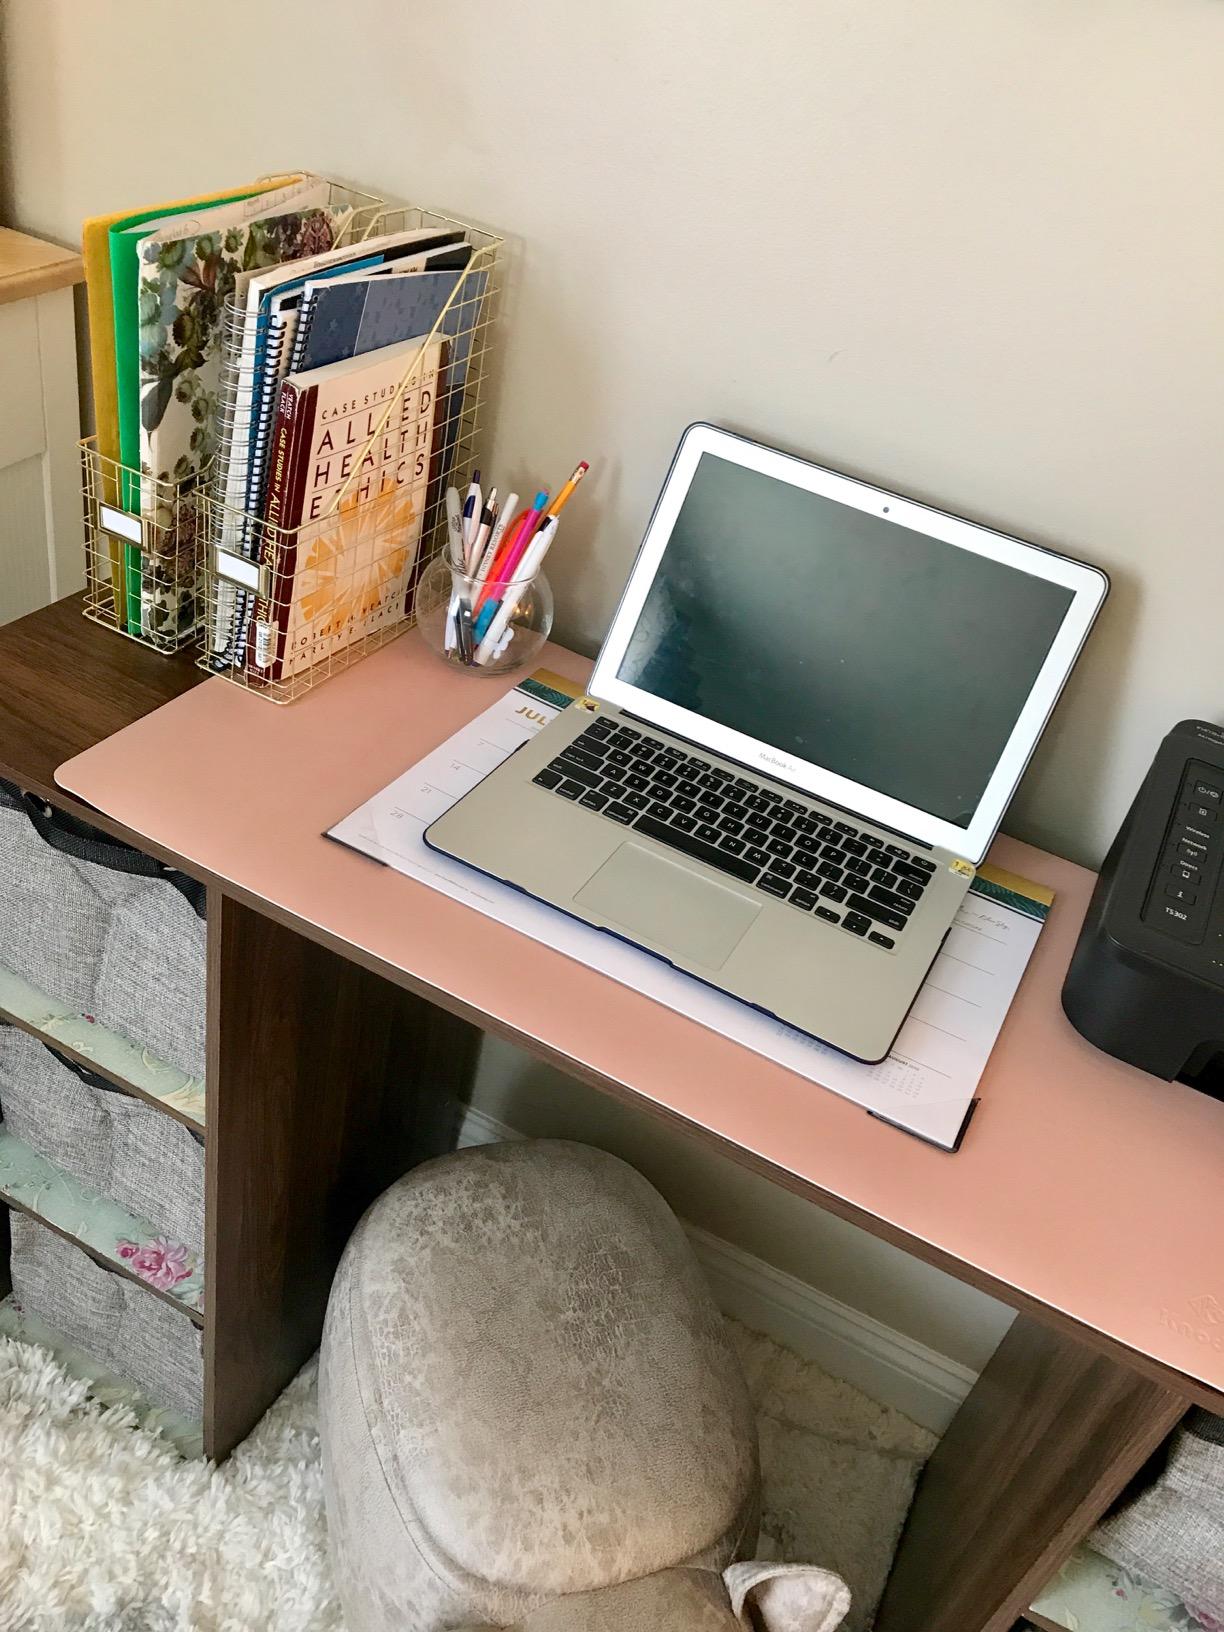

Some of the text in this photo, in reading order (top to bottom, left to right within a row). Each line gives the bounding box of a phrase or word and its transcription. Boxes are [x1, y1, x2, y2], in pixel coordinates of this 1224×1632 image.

[285, 393, 294, 420] VEATCH
[322, 401, 356, 420] CASE
[364, 378, 417, 405] STUDIS
[279, 427, 288, 448] CASE
[314, 421, 428, 488] HEALTH
[274, 450, 285, 483] STUDIES
[274, 482, 281, 492] IN
[515, 706, 546, 726] JUL
[451, 763, 461, 771] 14
[420, 786, 432, 795] 21
[390, 810, 404, 819] 28
